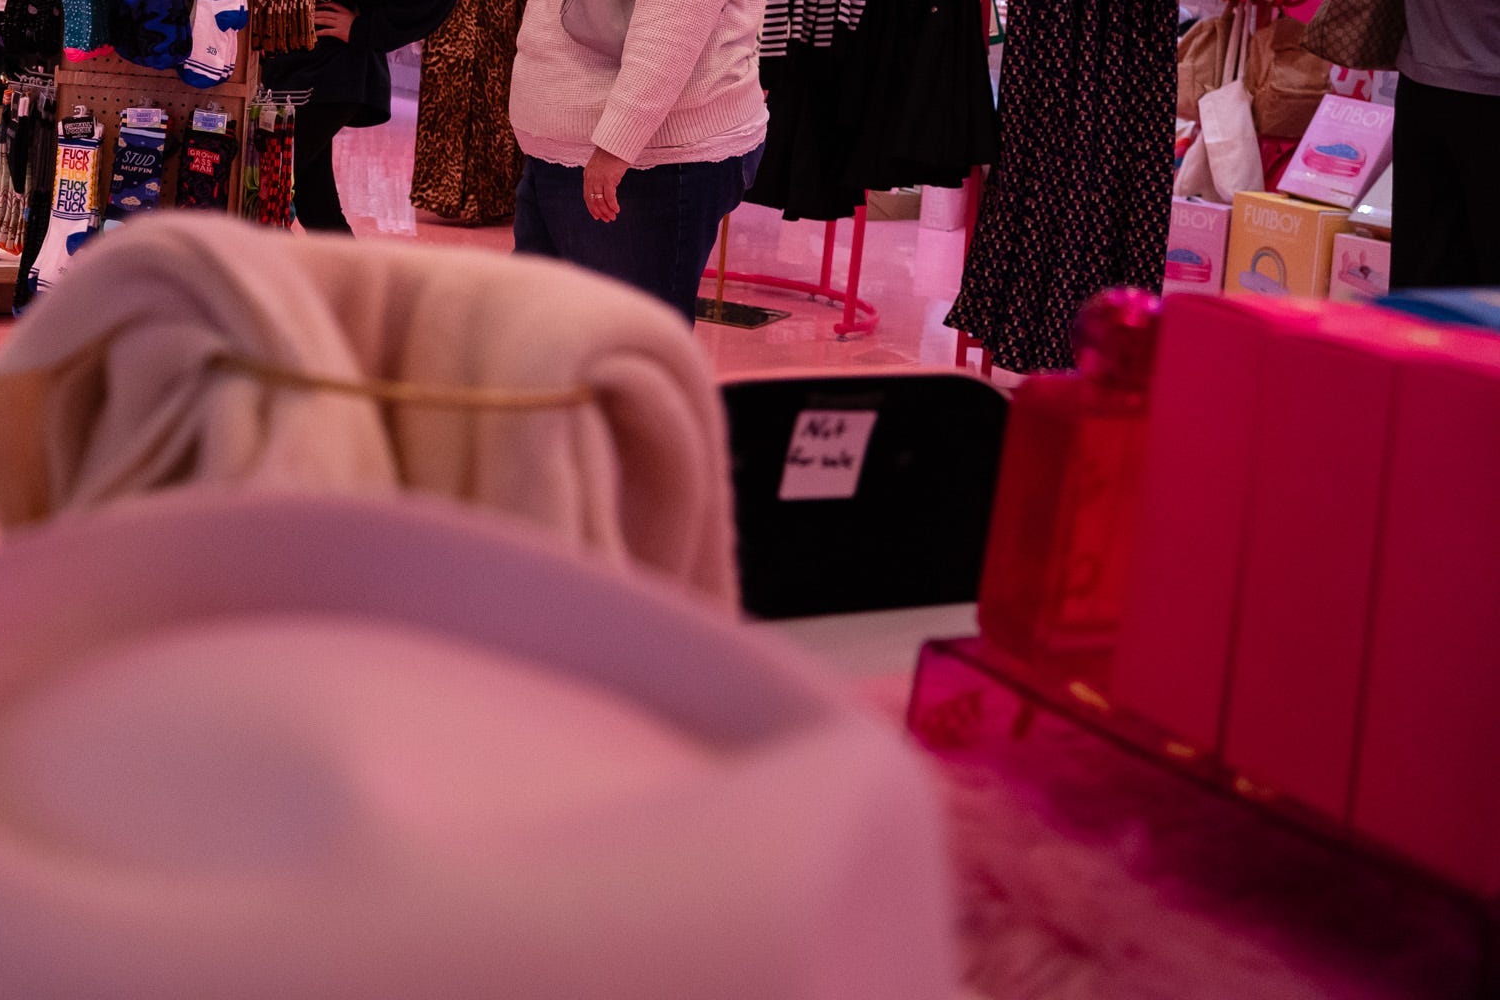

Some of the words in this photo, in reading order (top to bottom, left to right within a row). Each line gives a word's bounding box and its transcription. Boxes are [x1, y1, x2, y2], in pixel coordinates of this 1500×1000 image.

[1321, 101, 1392, 129] FUNBOY
[62, 148, 90, 162] FUCK
[123, 150, 156, 166] STUD
[189, 149, 220, 161] GROWN
[61, 159, 89, 171] FUCK
[192, 163, 212, 173] MAN
[194, 157, 212, 167] ASS
[61, 169, 88, 180] FUCK
[121, 165, 153, 174] MUFFIN
[60, 179, 88, 192] FUCK
[58, 190, 87, 202] FUCK
[57, 200, 85, 212] FUCK
[1172, 208, 1218, 231] NBOY
[1244, 204, 1302, 234] FUNBOY
[802, 417, 846, 440] Not
